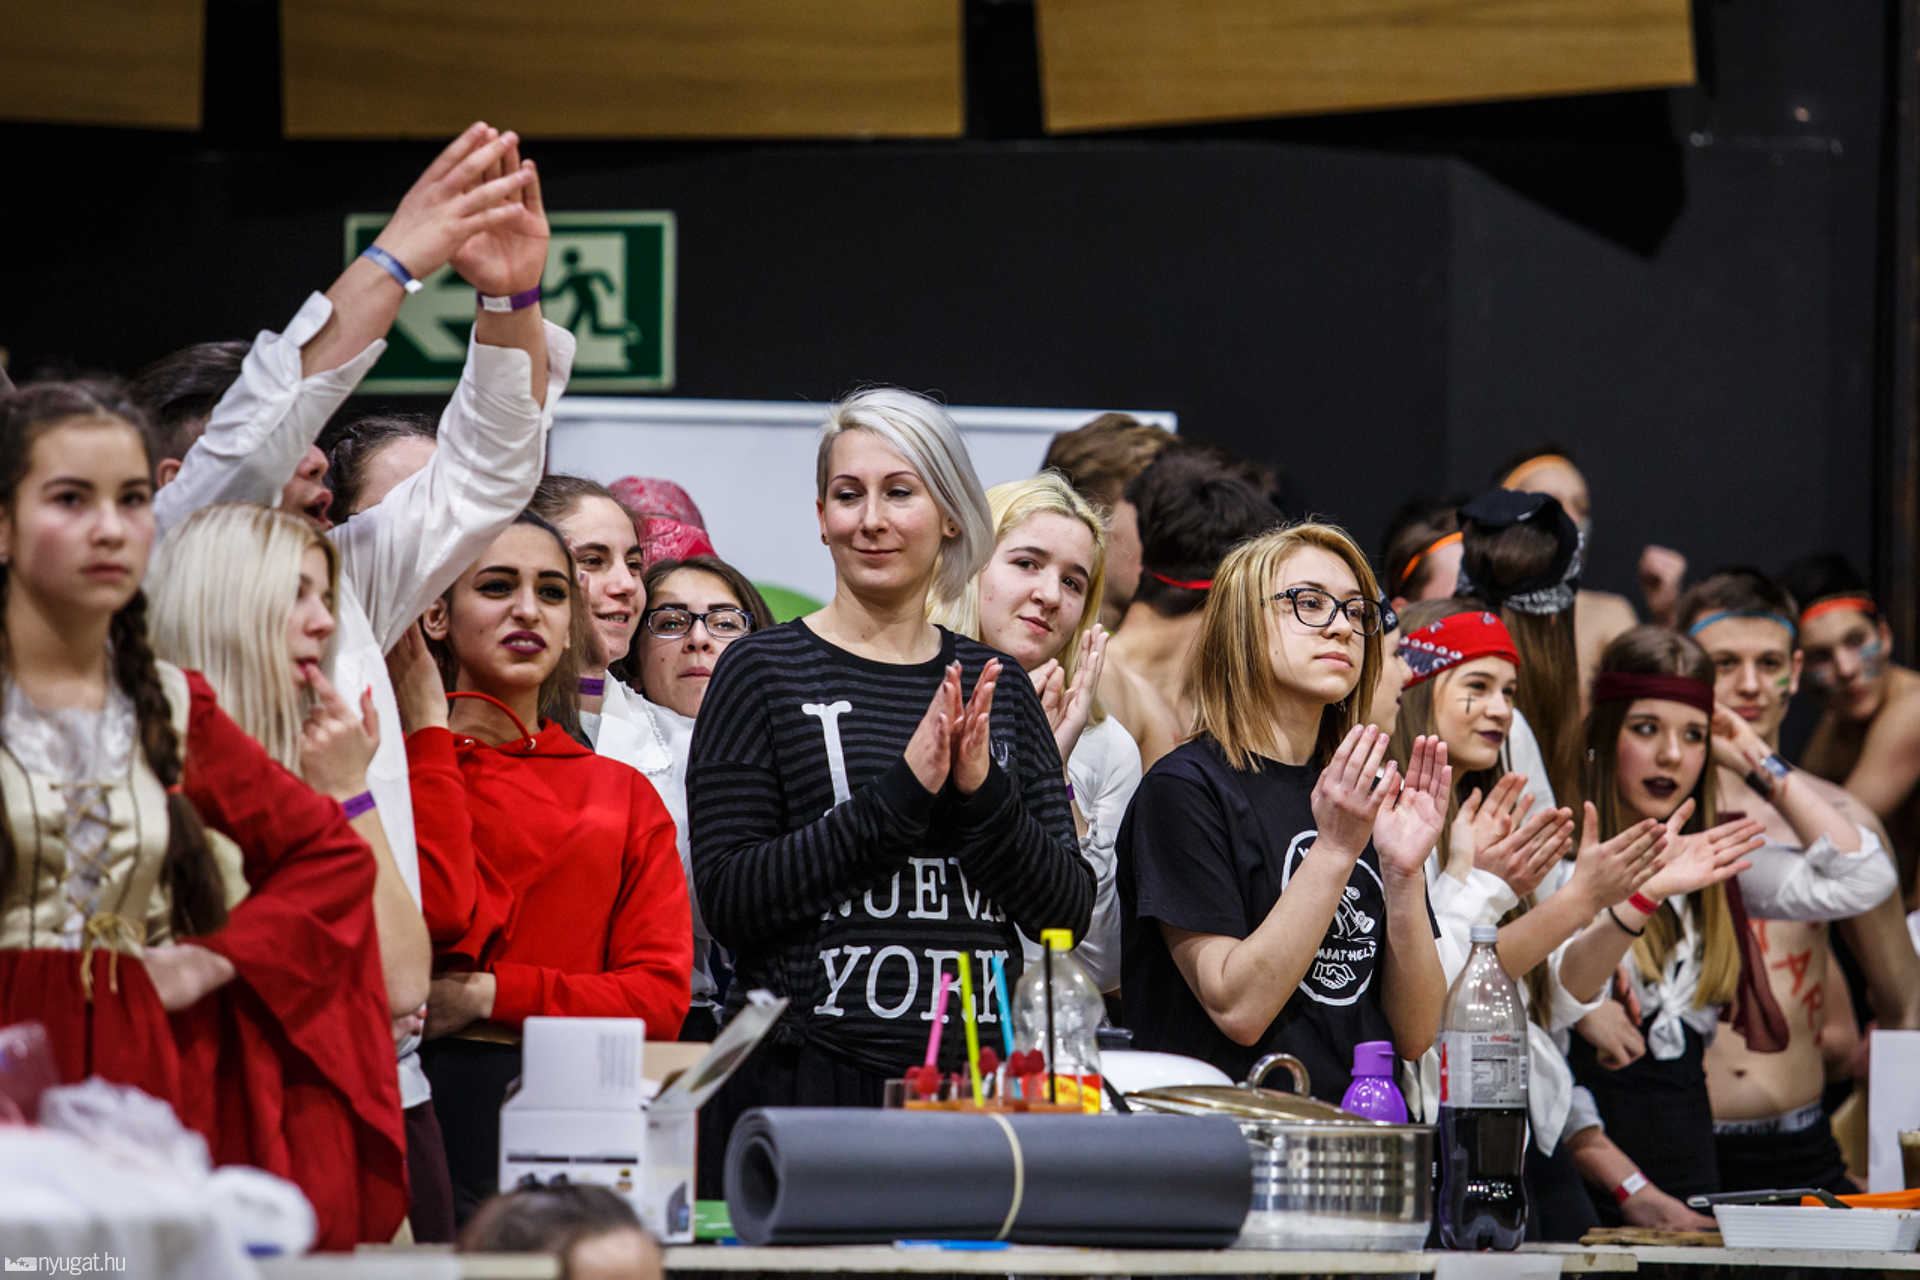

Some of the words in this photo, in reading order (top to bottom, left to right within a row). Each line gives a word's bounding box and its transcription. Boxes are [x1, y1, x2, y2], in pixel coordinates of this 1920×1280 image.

[801, 700, 853, 816] I
[820, 856, 1007, 922] UEV
[813, 945, 1010, 1024] YORK
